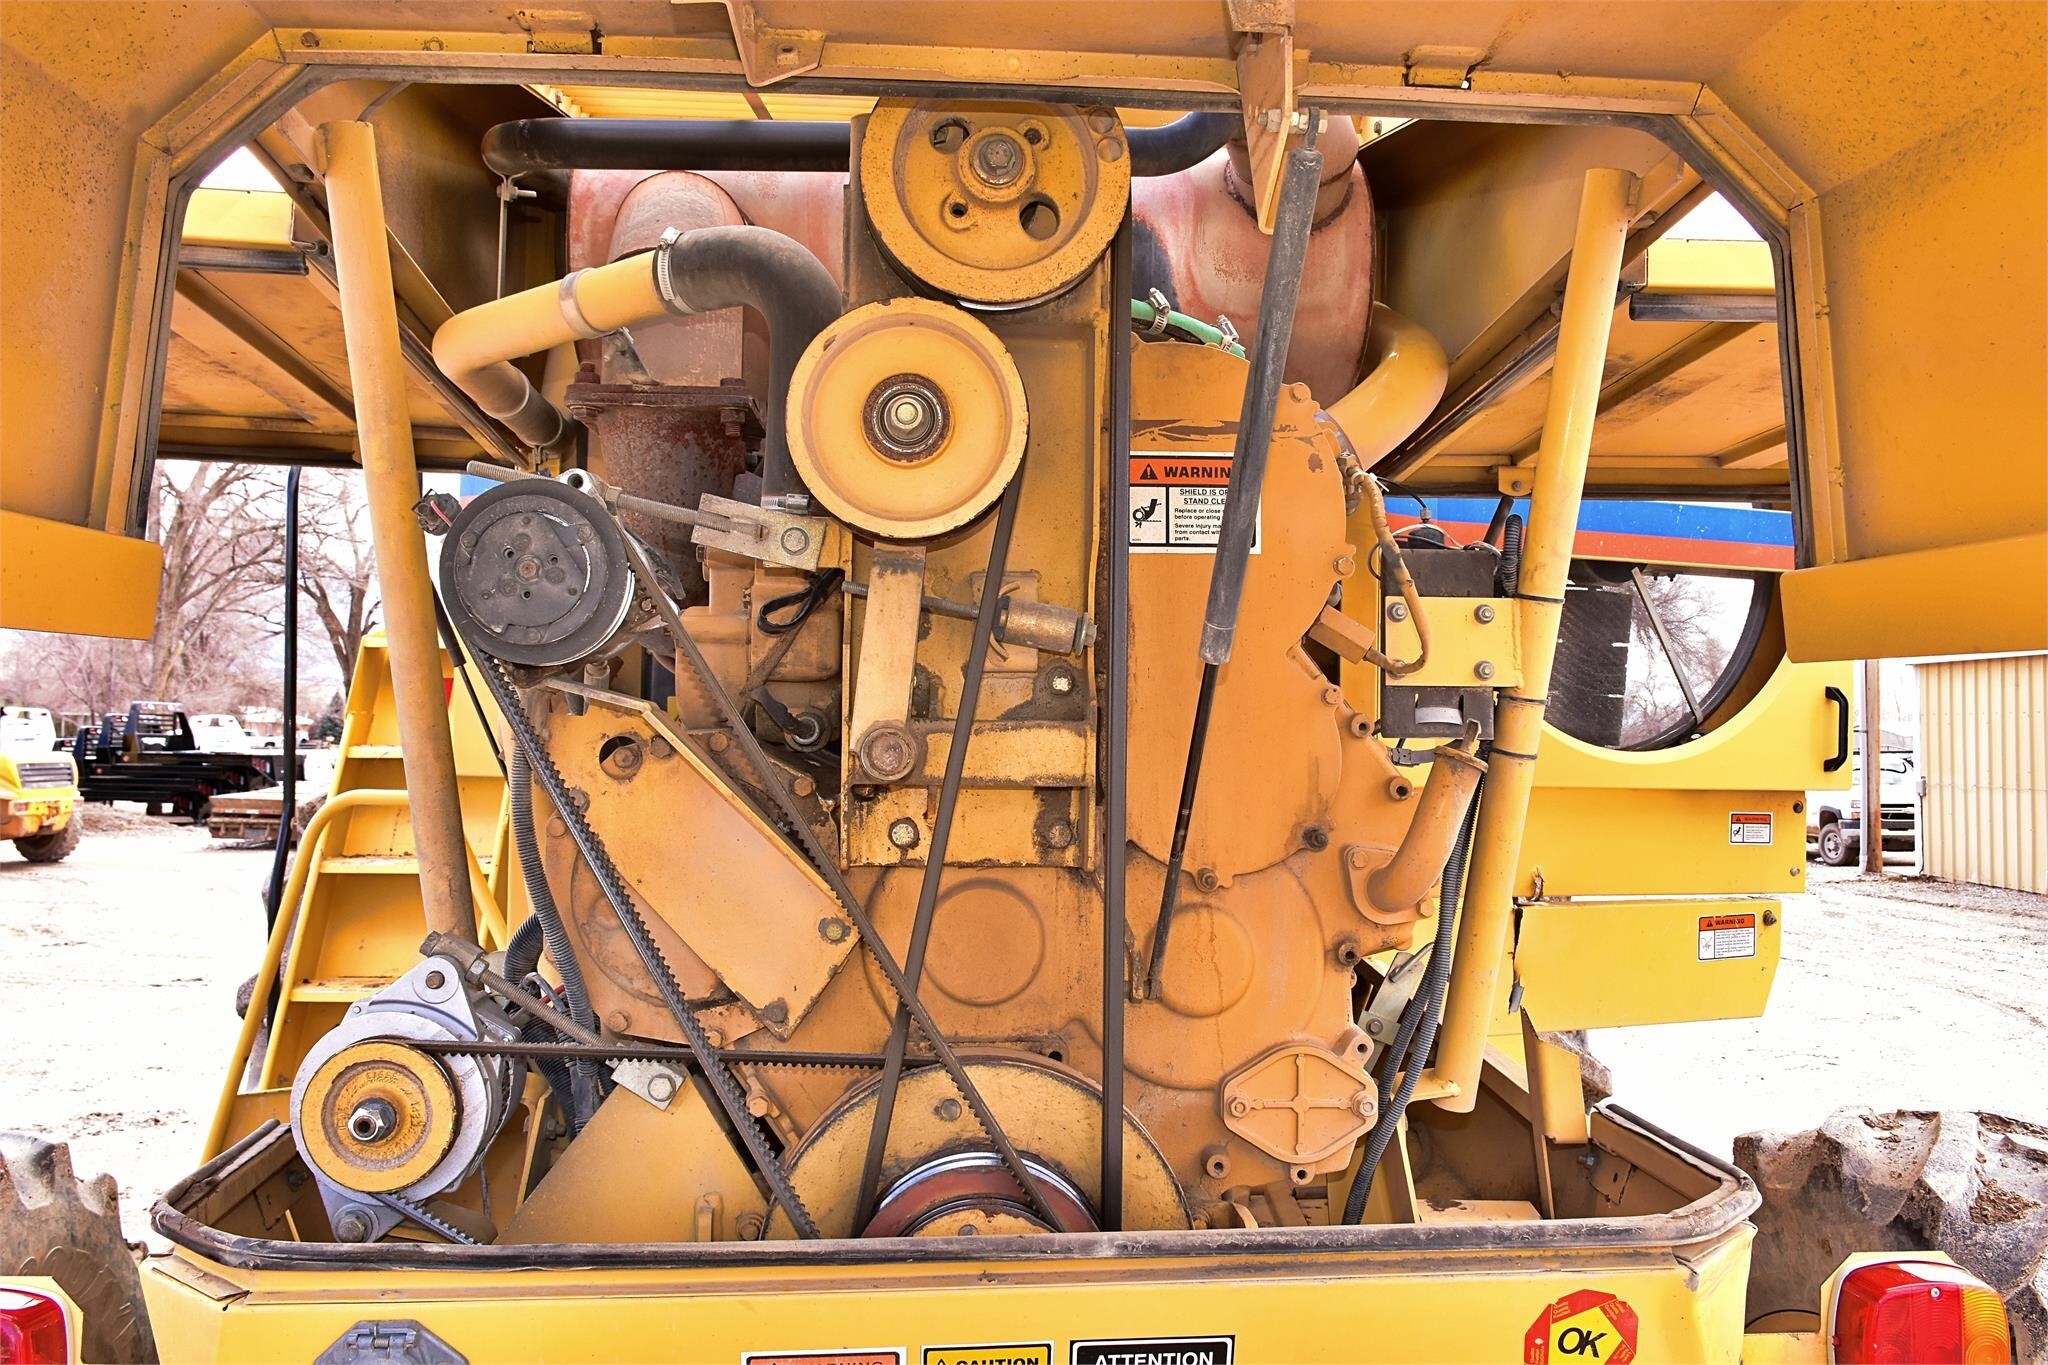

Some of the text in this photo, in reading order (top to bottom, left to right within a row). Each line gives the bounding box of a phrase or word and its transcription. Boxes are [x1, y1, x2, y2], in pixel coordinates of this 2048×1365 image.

[1164, 466, 1231, 478] WARNIN
[1180, 488, 1207, 496] SHIELD
[1209, 488, 1217, 496] IS
[1183, 497, 1226, 505] STAND CLE
[1557, 1327, 1608, 1359] OK
[1095, 1351, 1214, 1365] ATTENTION
